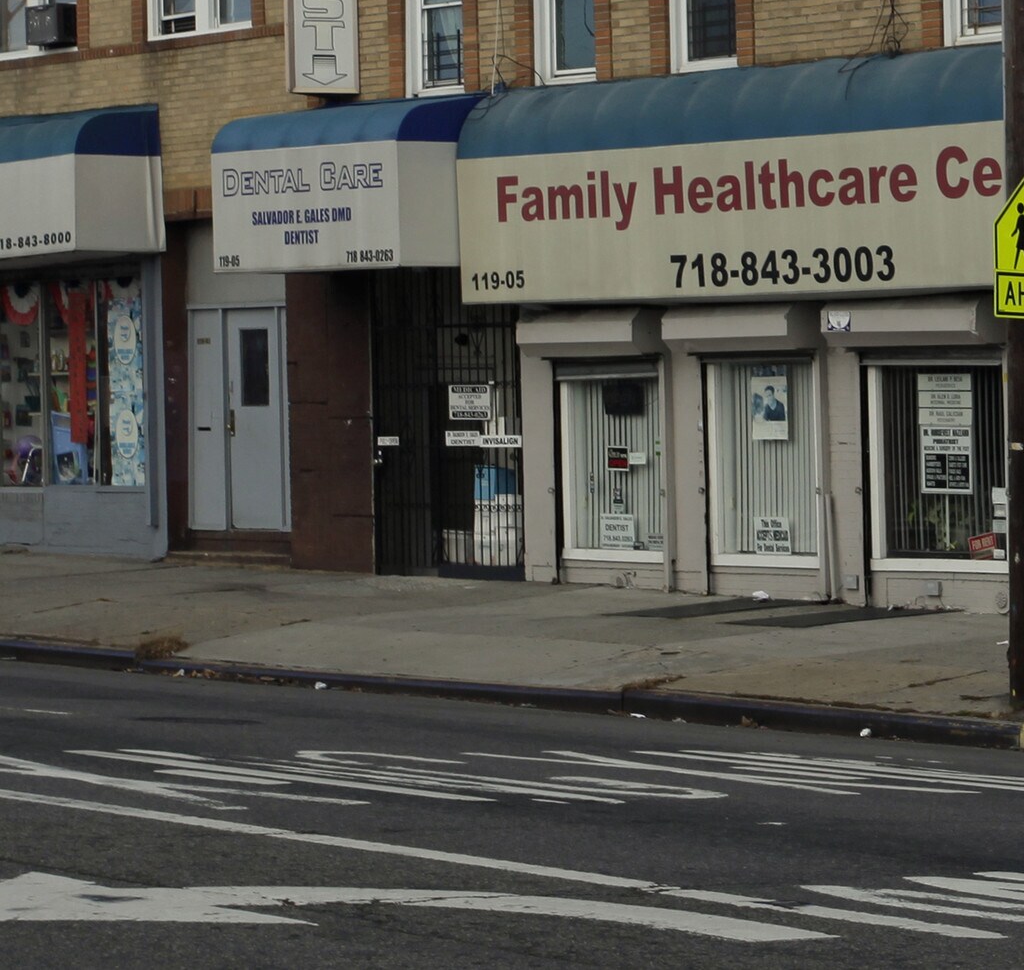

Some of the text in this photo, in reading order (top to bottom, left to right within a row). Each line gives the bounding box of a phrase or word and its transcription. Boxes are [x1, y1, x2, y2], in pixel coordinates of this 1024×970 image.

[222, 161, 383, 197] DENTAL CARE
[497, 170, 637, 231] Family
[653, 158, 918, 215] Healthcare
[252, 208, 294, 226] SALVADOR
[304, 208, 330, 224] GALES
[332, 206, 352, 222] DMD
[285, 230, 319, 245] DENTIST
[219, 255, 240, 268] 119-05
[346, 248, 394, 263] 718 843-0263
[670, 244, 896, 288] 718-843-3003
[472, 270, 525, 291] 119-05
[761, 519, 782, 528] This Office
[764, 543, 774, 552] Dental
[776, 544, 790, 552] Services
[972, 535, 993, 550] FOR RENT
